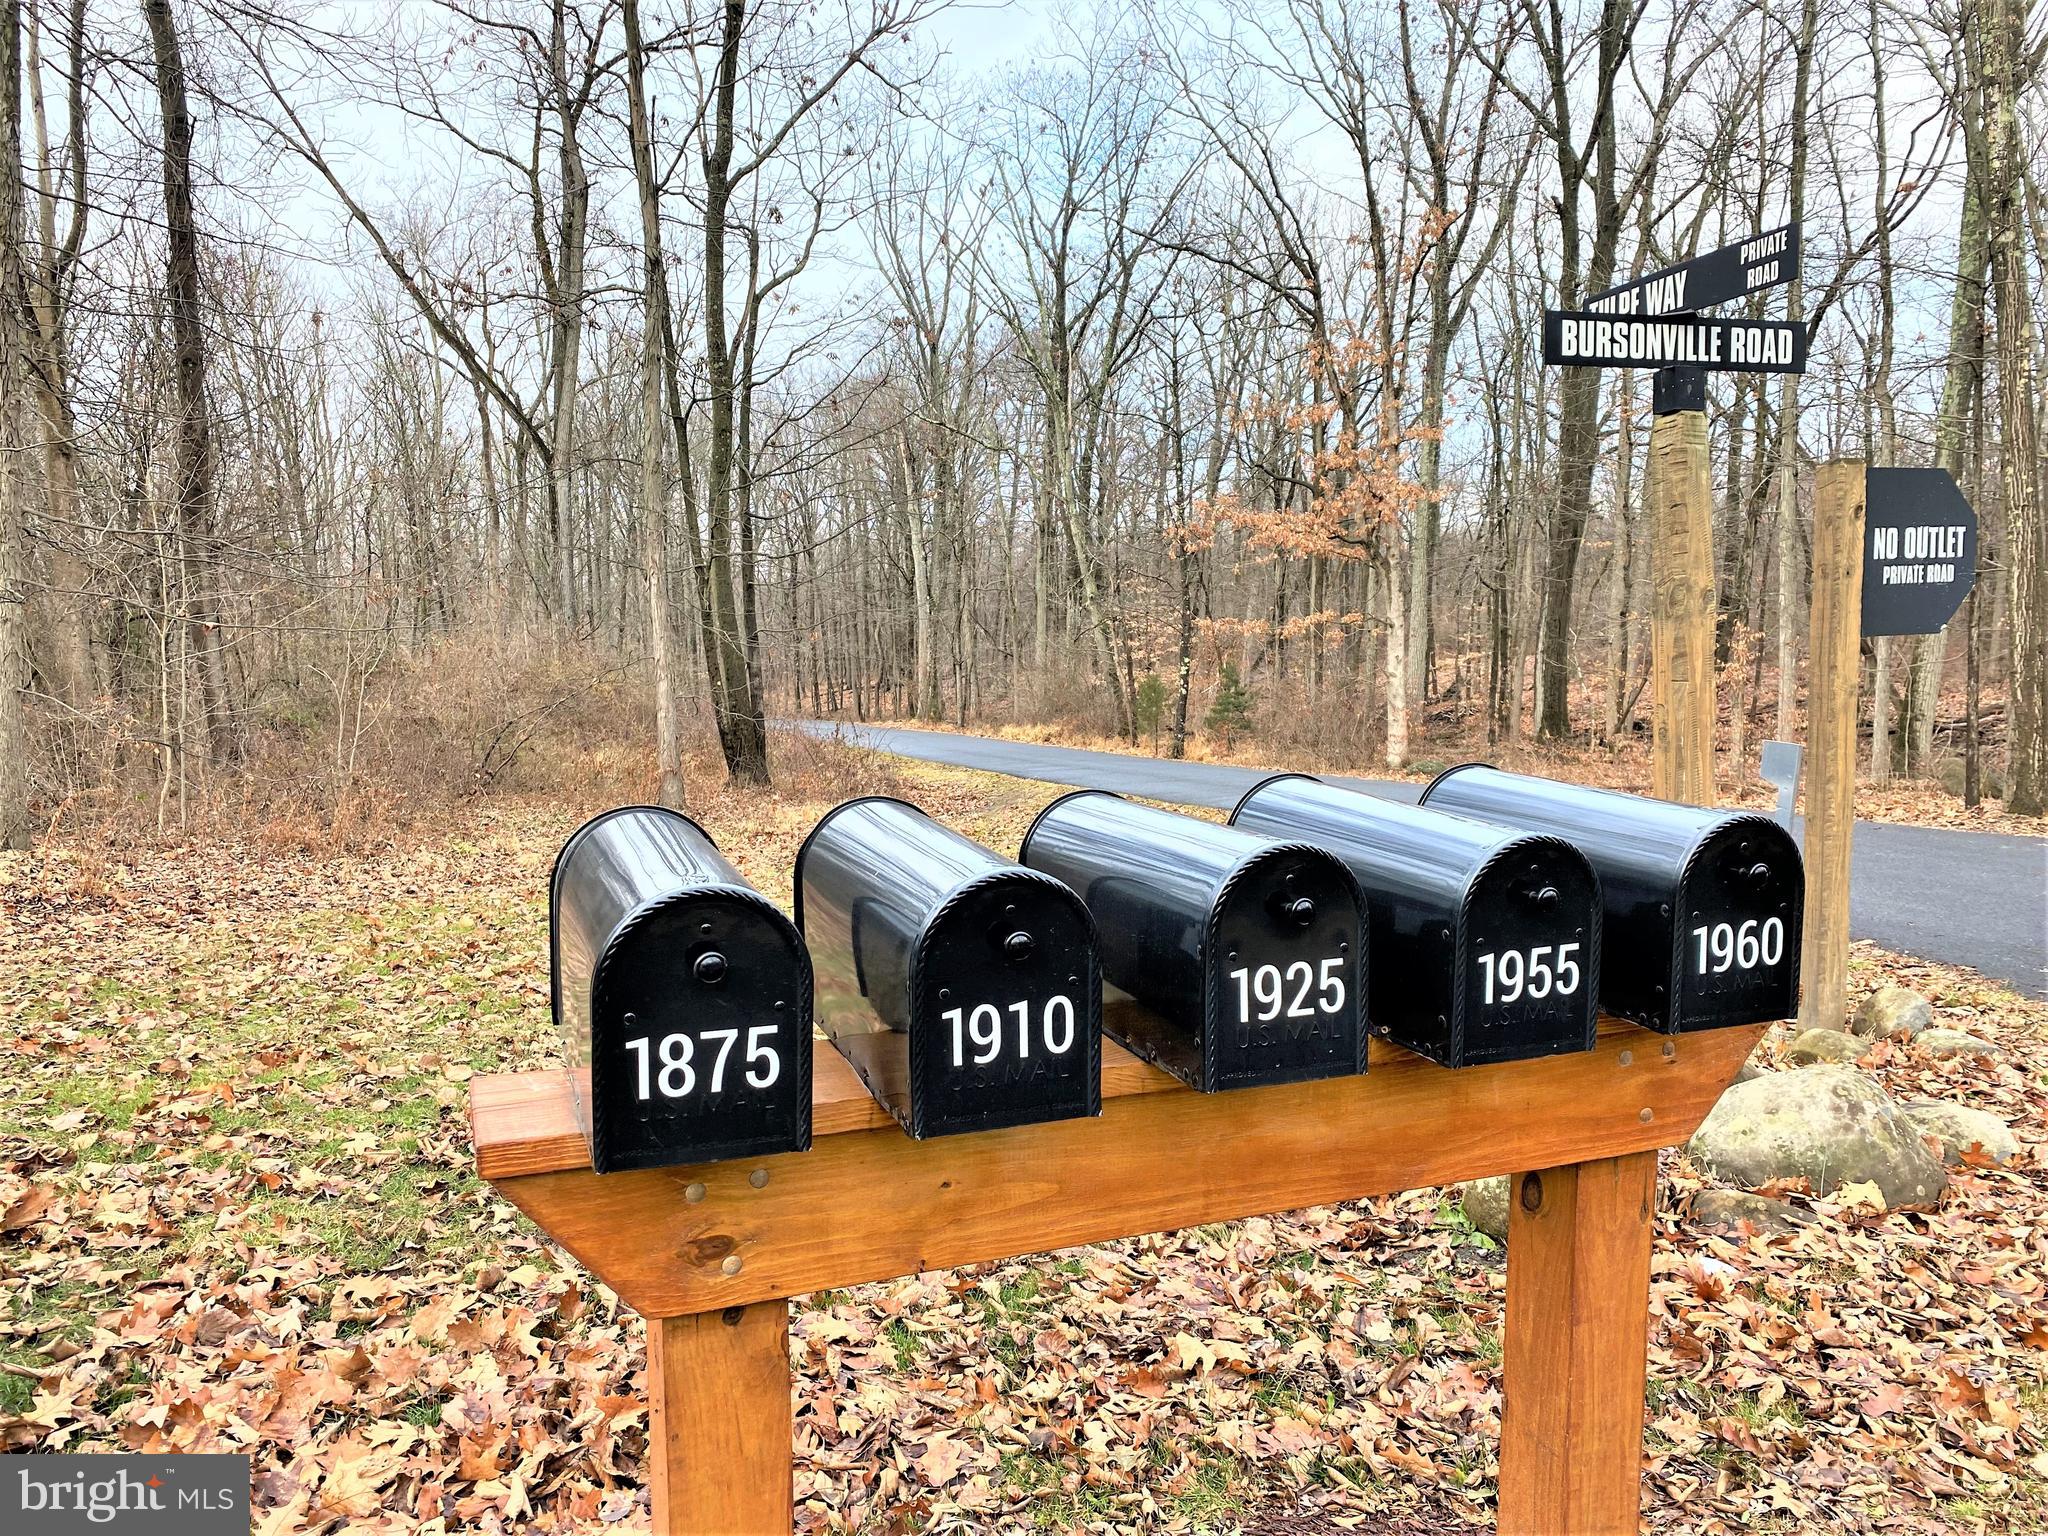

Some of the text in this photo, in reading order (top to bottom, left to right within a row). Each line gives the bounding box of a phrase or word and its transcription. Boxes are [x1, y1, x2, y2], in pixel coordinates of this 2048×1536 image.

[1740, 230, 1788, 265] PRIVATE
[1645, 270, 1688, 316] WAY
[1747, 260, 1779, 290] ROAD
[1561, 319, 1793, 365] BURSONVILLE ROAD
[1873, 525, 1967, 560] NO OUTLET
[1882, 563, 1954, 585] PRIVATE ROAD
[1692, 917, 1784, 975] 1960
[1230, 957, 1346, 1023] 1925
[1478, 942, 1580, 1005] 1955
[941, 995, 1075, 1067] 1910
[625, 1024, 781, 1101] 1875
